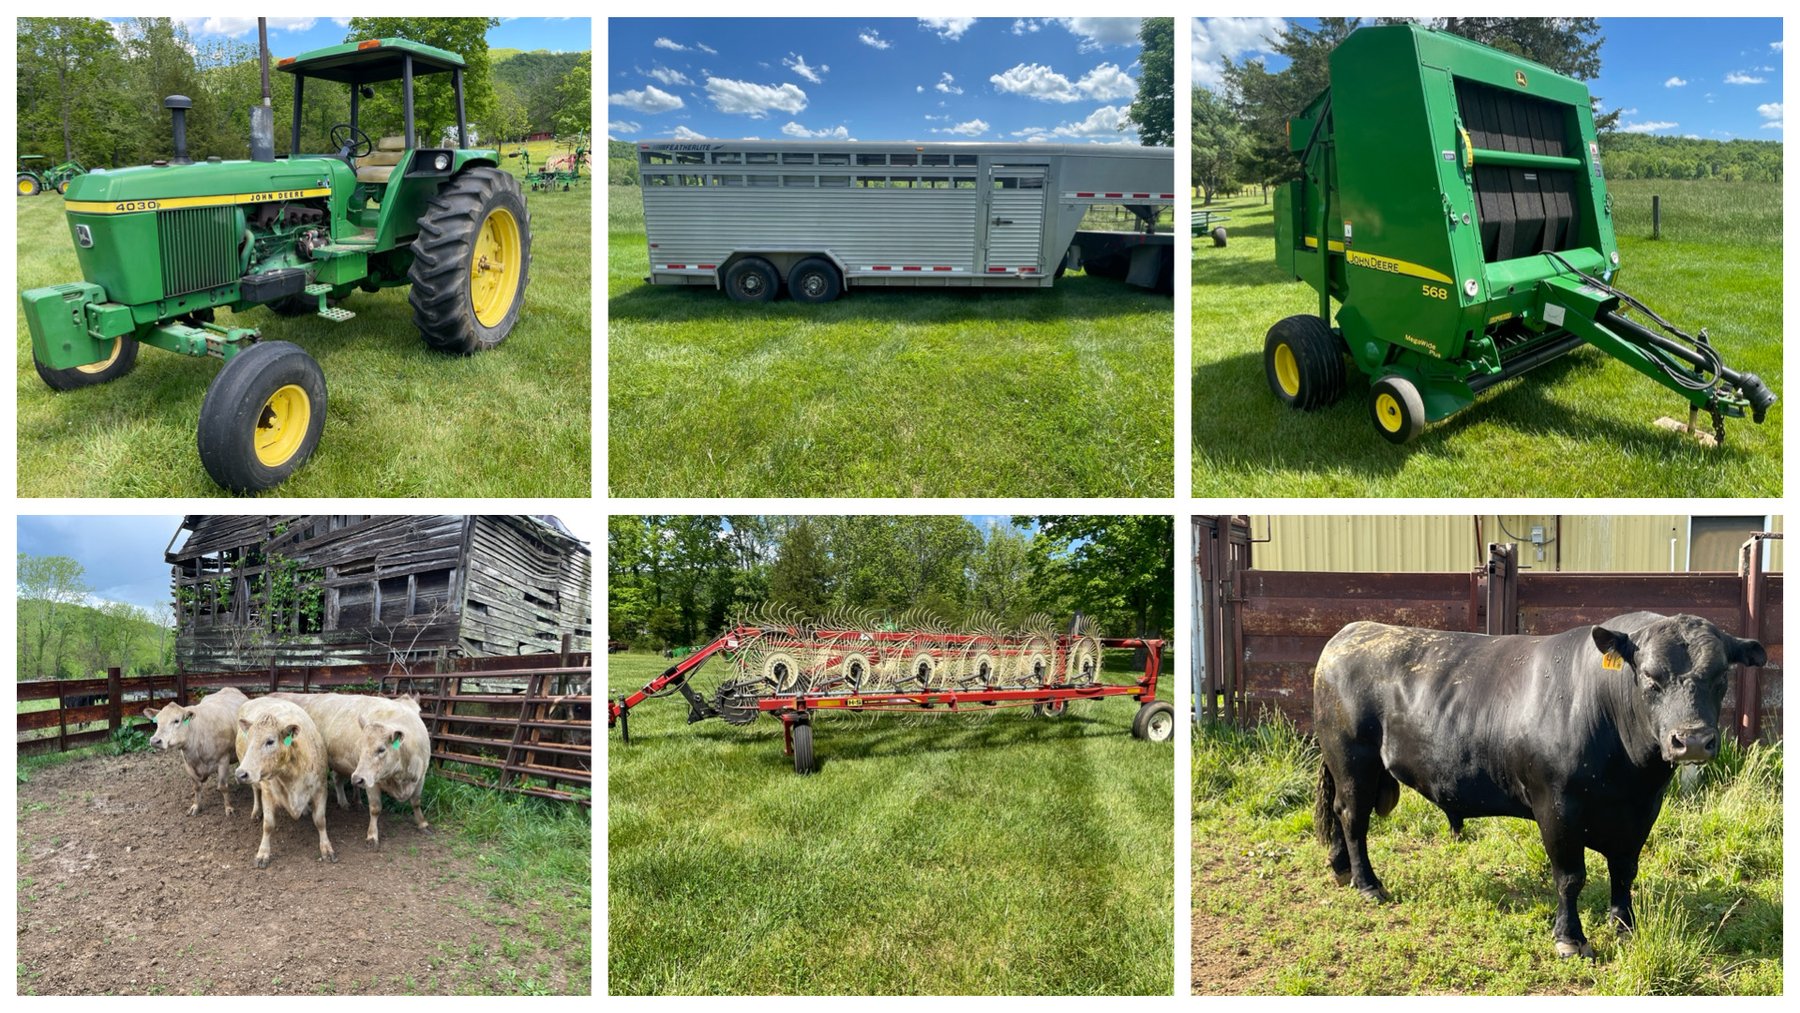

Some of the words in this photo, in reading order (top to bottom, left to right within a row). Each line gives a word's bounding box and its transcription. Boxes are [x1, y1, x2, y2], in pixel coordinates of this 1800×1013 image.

[278, 191, 304, 199] DEERE
[116, 201, 156, 211] 4030
[1422, 285, 1447, 300] 568
